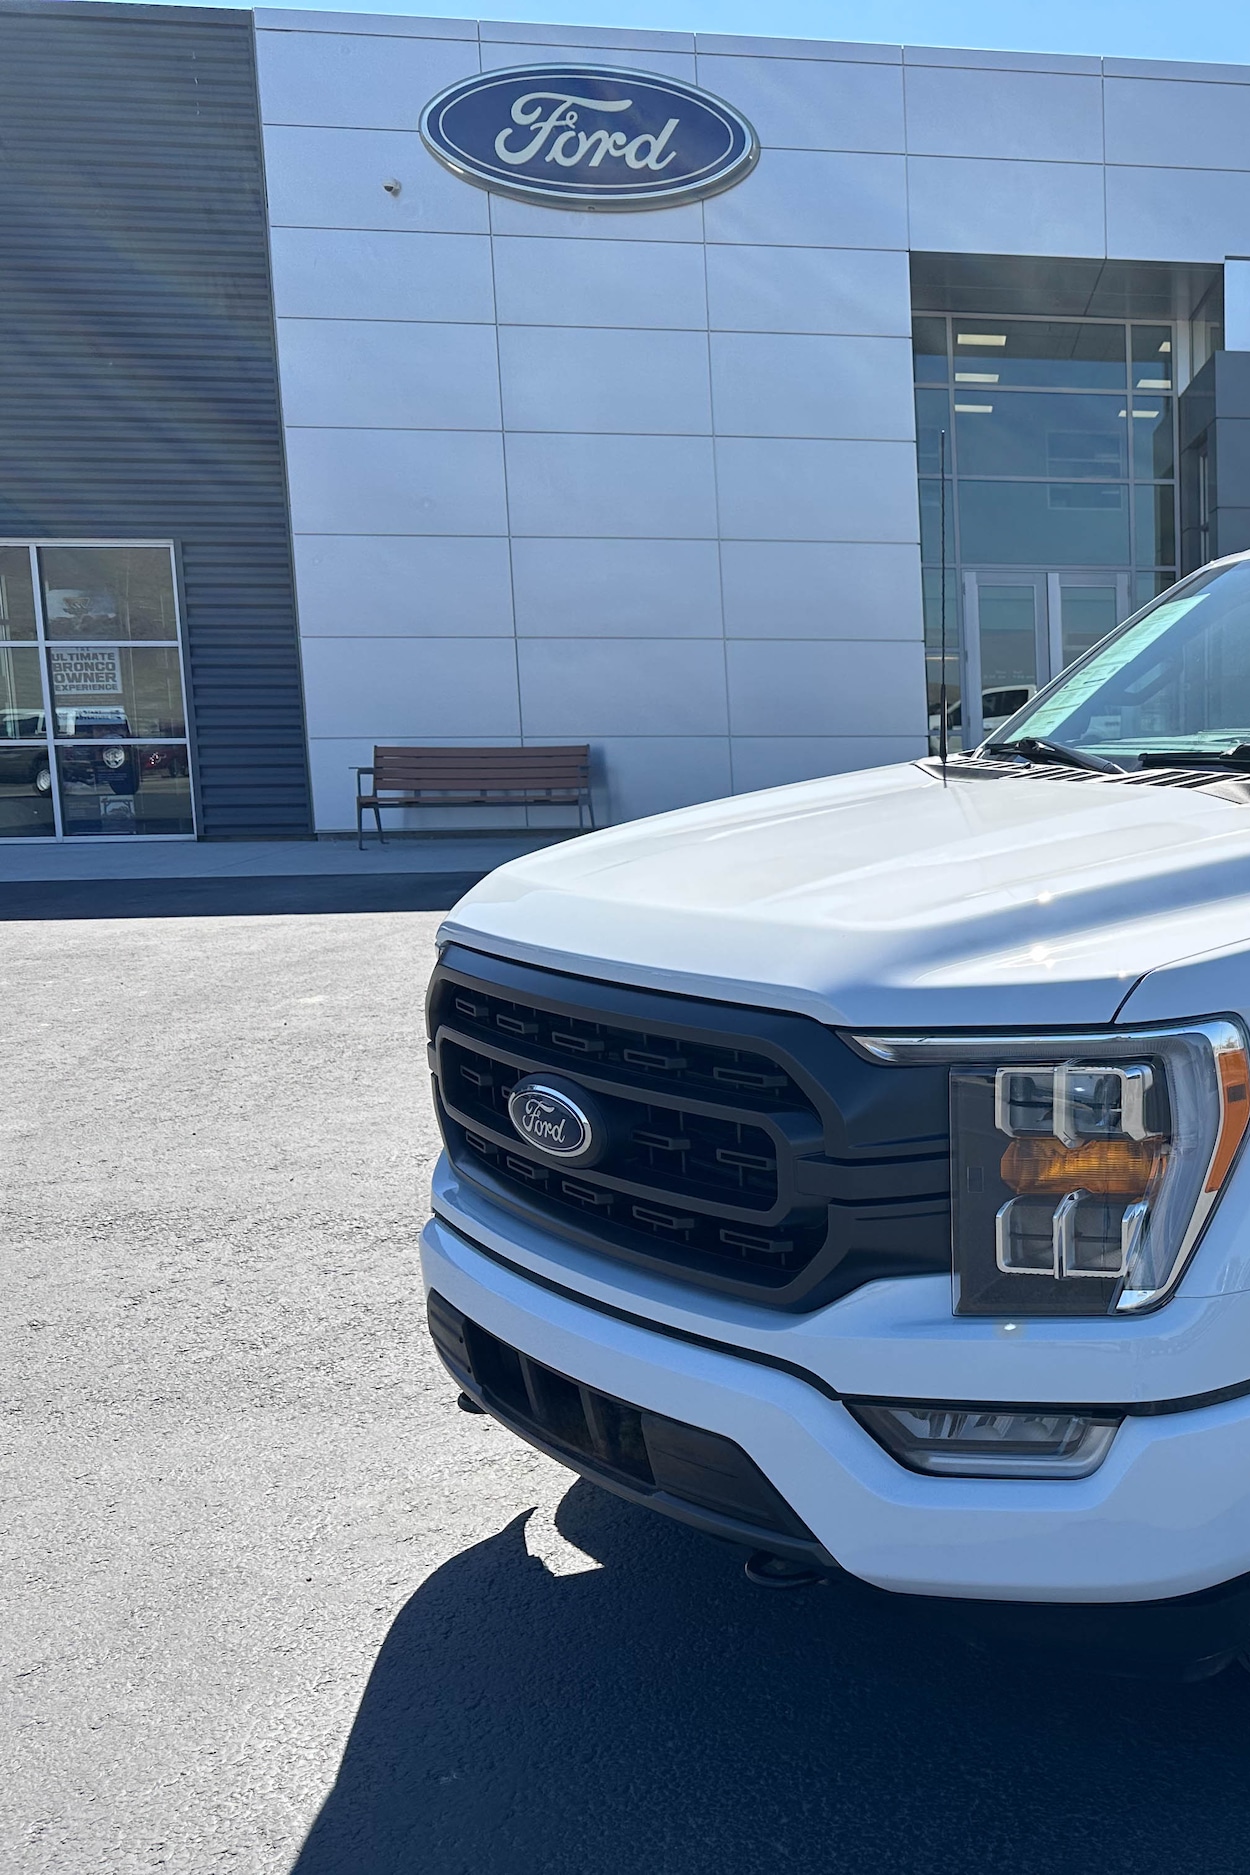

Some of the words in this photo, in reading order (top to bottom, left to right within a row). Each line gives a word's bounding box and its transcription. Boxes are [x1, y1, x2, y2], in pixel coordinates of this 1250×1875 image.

[494, 92, 680, 170] Ford
[52, 652, 116, 662] ULTIMATE
[53, 661, 116, 672] BRONCO
[54, 672, 117, 683] OWNER
[55, 683, 118, 692] EXPERIENCE
[522, 1098, 566, 1144] Ford
